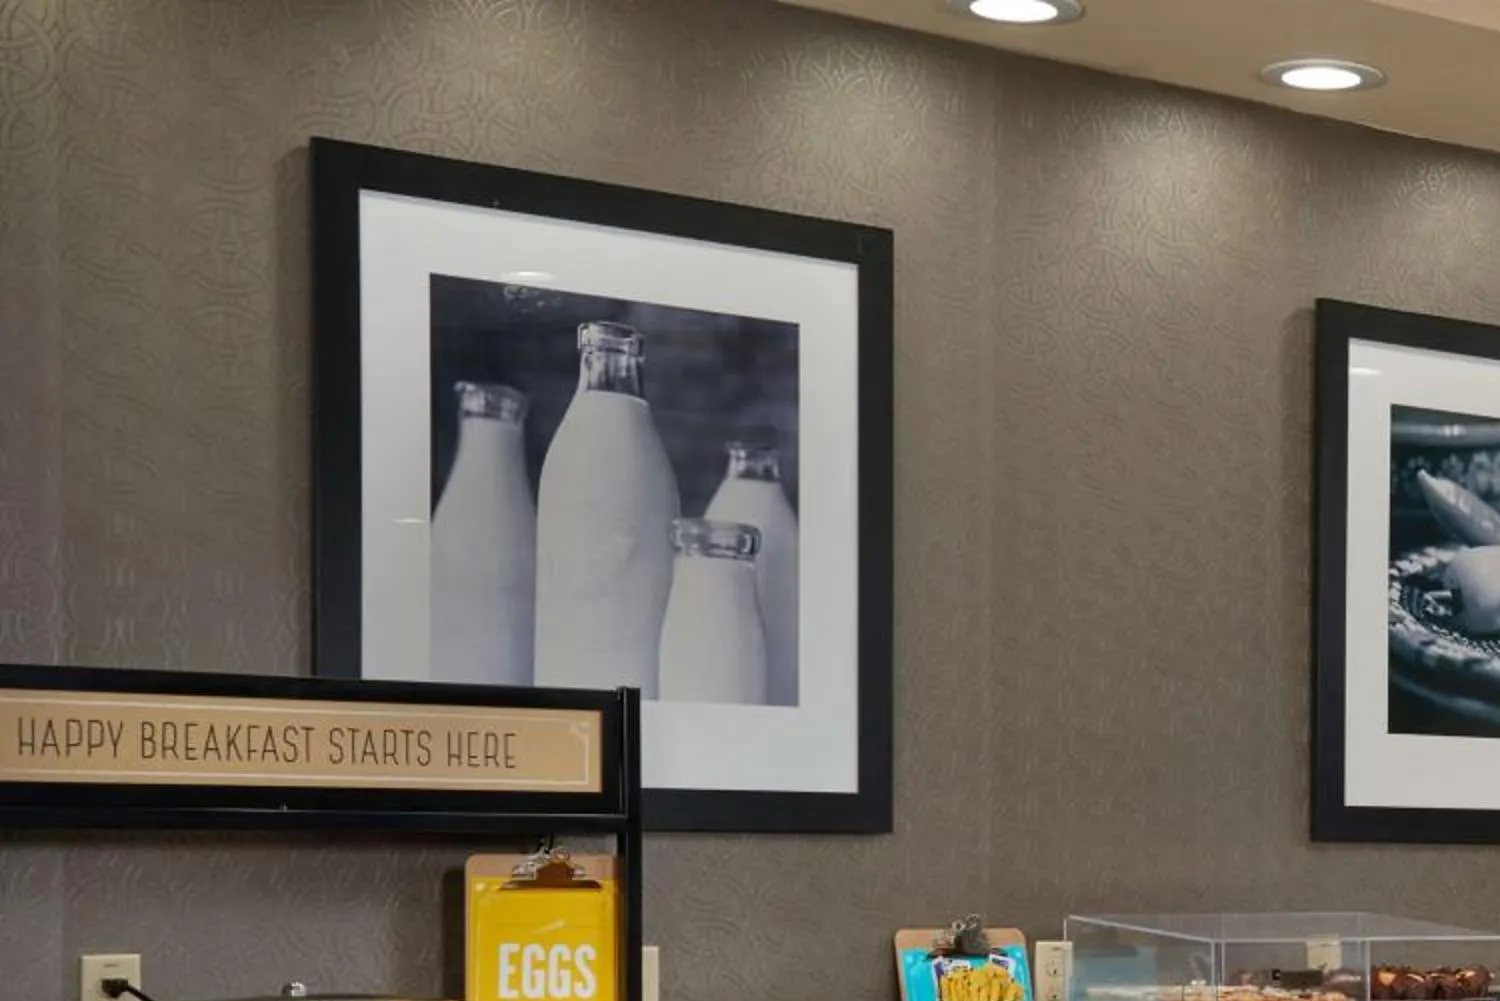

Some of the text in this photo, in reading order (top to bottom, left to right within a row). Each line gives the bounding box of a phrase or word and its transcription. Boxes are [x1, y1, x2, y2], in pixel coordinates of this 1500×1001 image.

[17, 716, 517, 769] HAPPY BREAKFAST STARTS HERE
[499, 943, 598, 1000] EGGS
